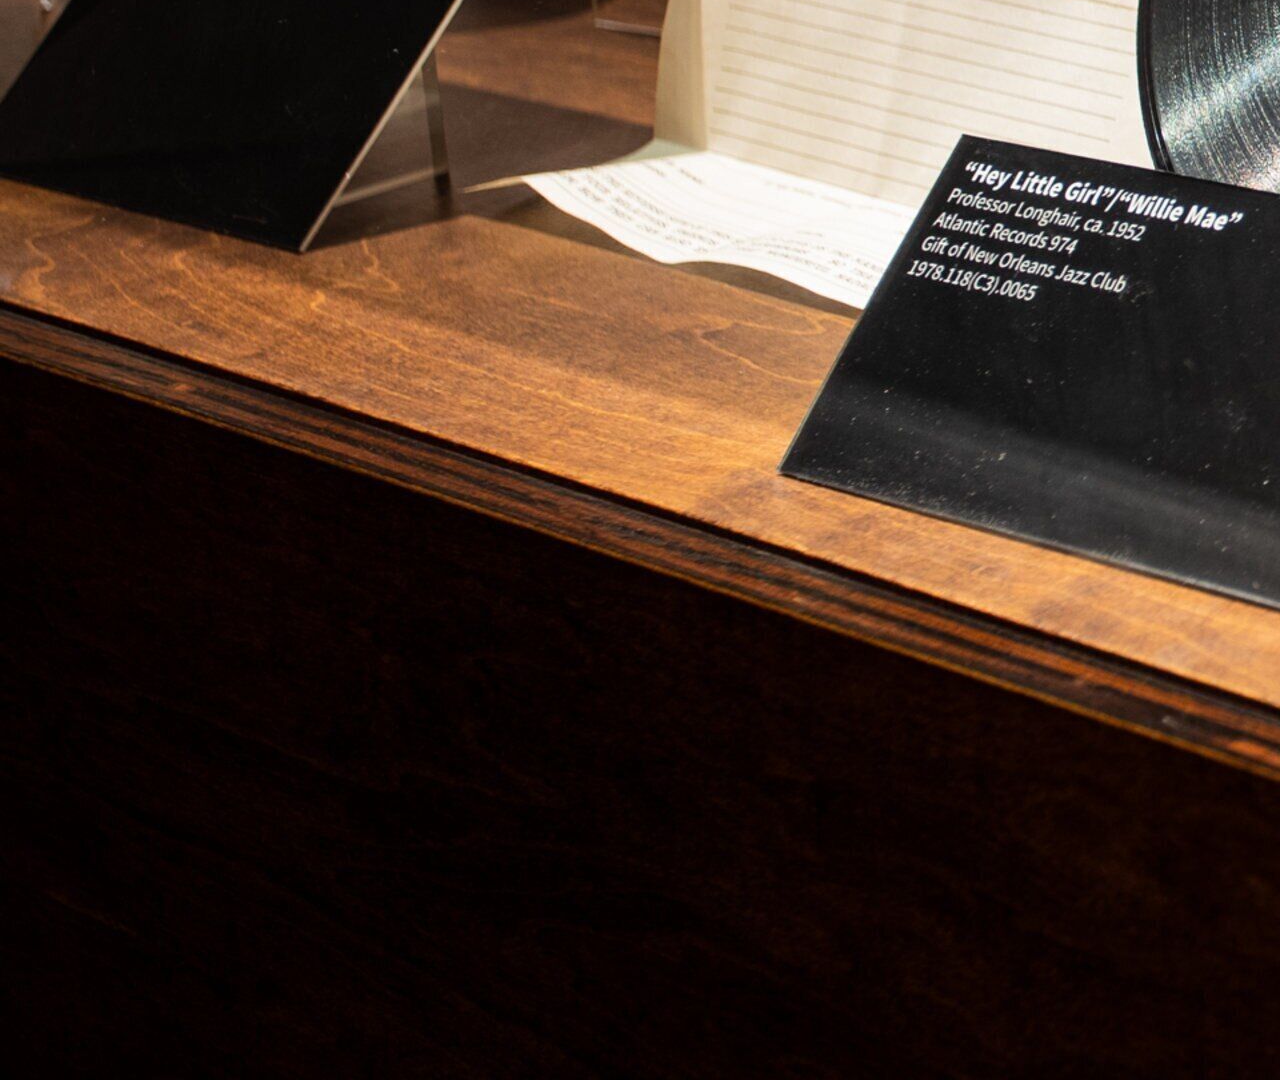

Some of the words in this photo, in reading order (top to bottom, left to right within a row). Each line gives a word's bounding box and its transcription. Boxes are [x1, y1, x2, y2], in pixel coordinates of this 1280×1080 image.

[947, 187, 1016, 214] Professor
[1014, 201, 1080, 231] Longhair,
[1084, 218, 1103, 233] ca.
[1107, 220, 1144, 241] 1952
[966, 160, 1012, 191] “Hey
[1010, 170, 1062, 197] Little
[1064, 182, 1183, 221] Girl”/“Willie
[1184, 204, 1242, 230] Mae”
[932, 211, 989, 236] Atlantic
[989, 222, 1048, 248] Records
[1048, 235, 1078, 254] 974
[906, 260, 1038, 301] 1978.118(C3).0065
[922, 235, 948, 254] Gift
[948, 241, 969, 257] of
[963, 244, 999, 264] New
[999, 251, 1055, 277] Orleans
[1055, 264, 1091, 285] Jazz
[1091, 271, 1126, 292] Club
